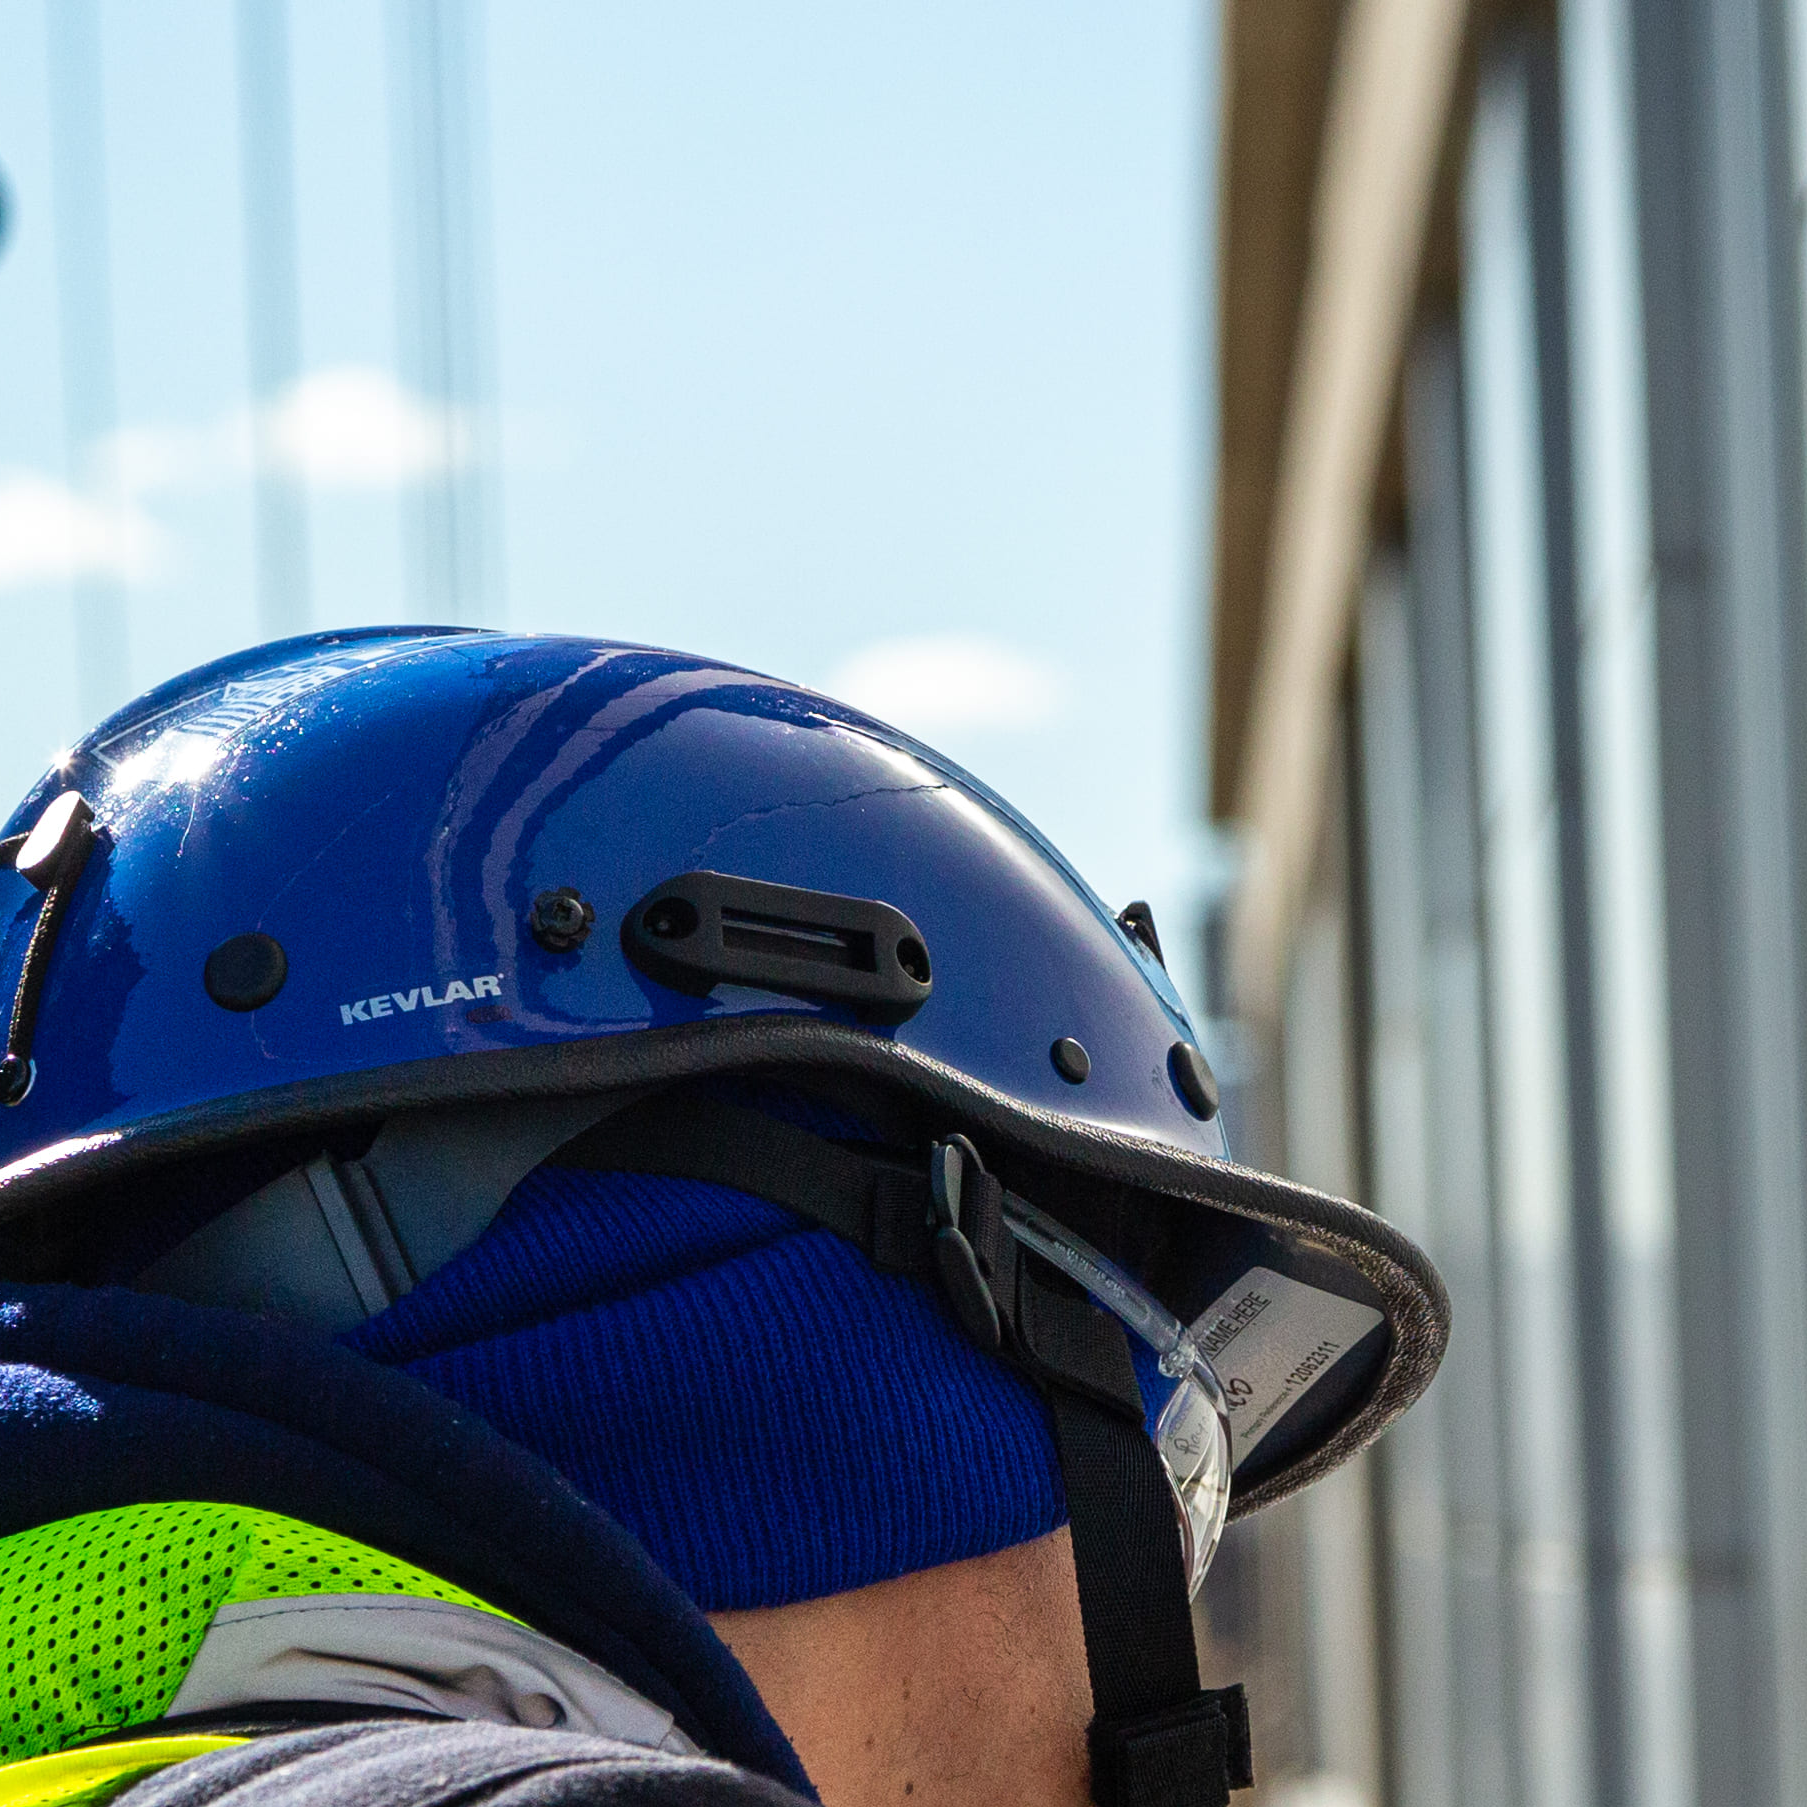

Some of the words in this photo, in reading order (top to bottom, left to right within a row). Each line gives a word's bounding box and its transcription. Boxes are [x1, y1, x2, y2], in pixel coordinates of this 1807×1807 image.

[339, 975, 502, 1026] KEVLAR
[1200, 1319, 1239, 1357] NAME
[1229, 1291, 1269, 1325] HERE
[1286, 1341, 1340, 1388] 12062311
